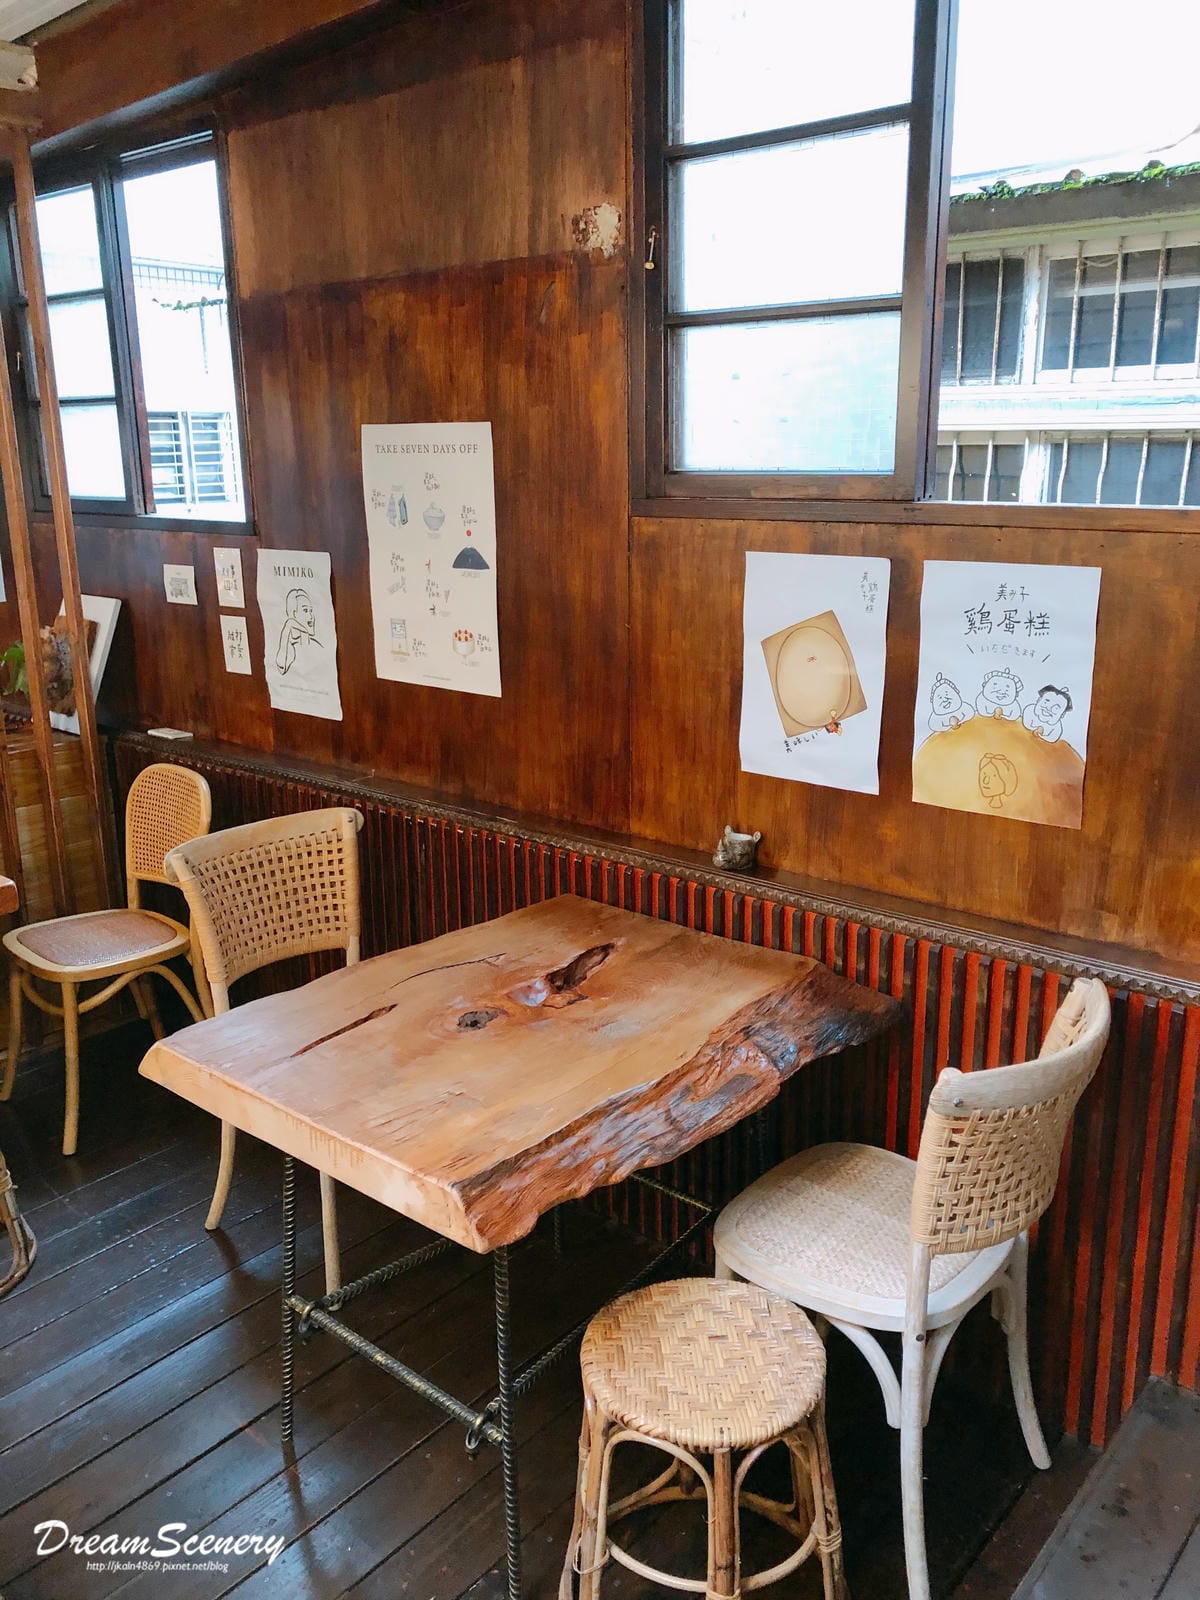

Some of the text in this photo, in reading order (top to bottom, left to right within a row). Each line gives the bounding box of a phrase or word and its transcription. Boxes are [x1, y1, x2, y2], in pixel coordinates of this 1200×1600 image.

[375, 443, 478, 454] TAKE SEVEN DAYS OFF
[273, 565, 314, 579] MIMIKO
